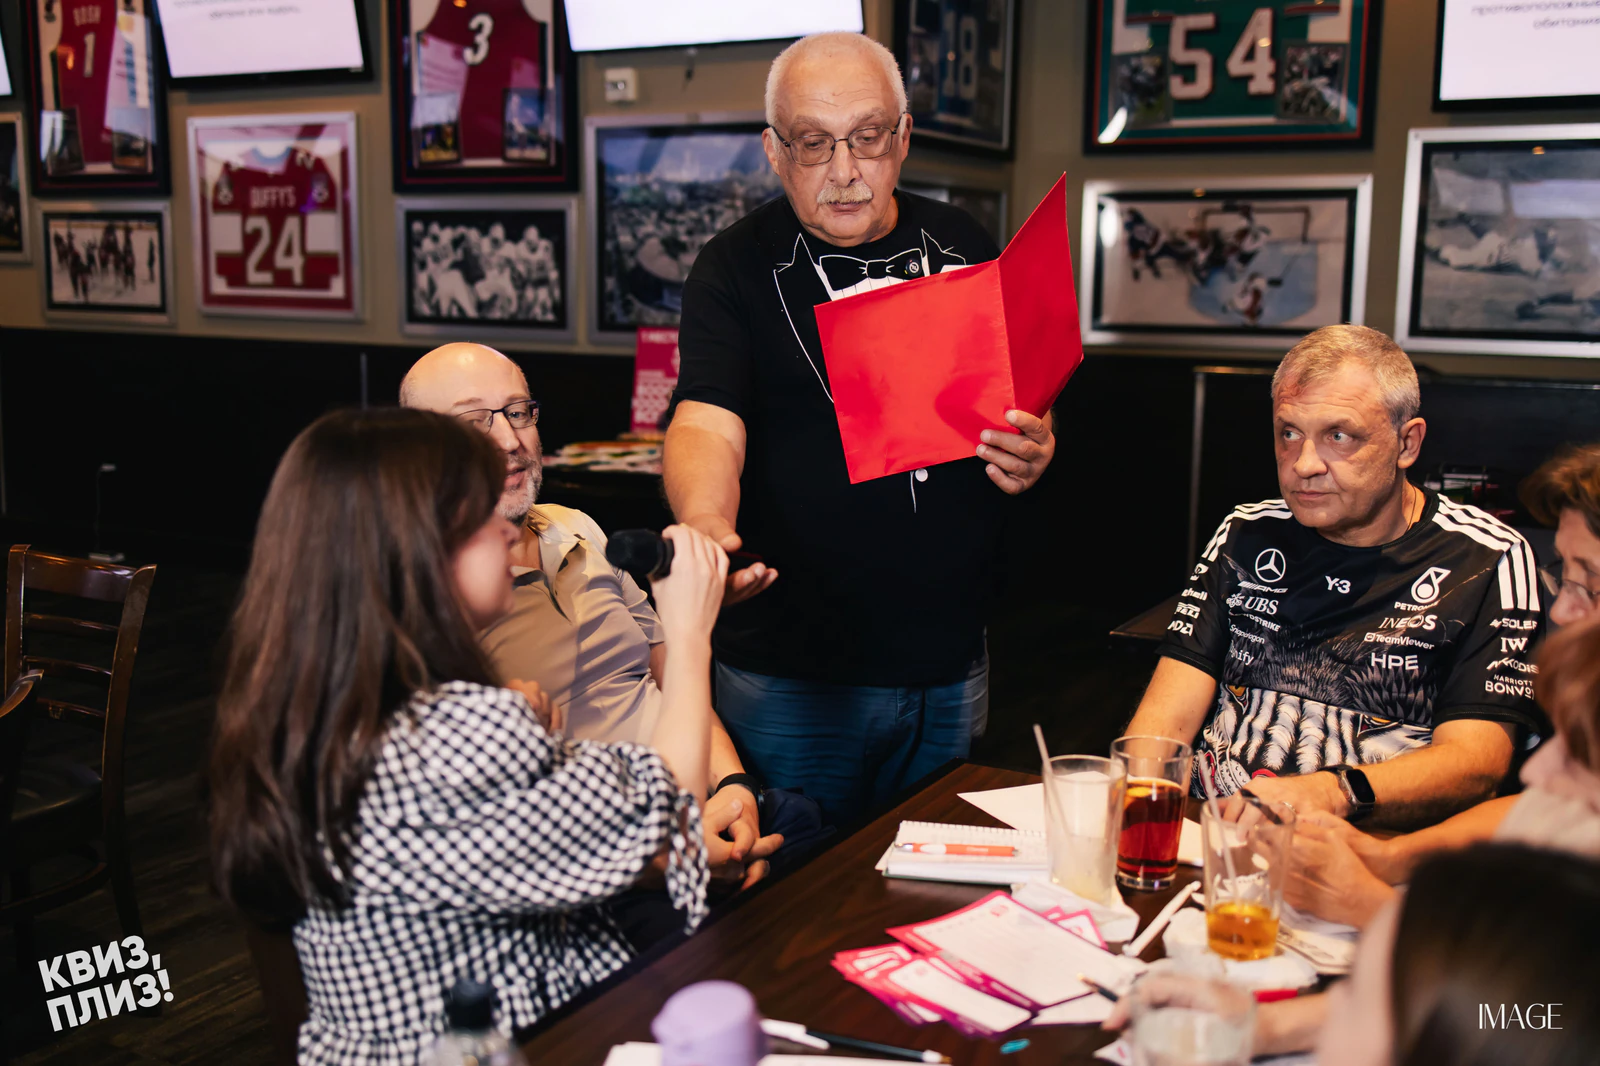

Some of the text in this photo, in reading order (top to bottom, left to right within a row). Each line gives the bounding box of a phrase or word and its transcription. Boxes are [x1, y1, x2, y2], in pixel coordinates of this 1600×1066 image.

[463, 12, 494, 66] 3
[83, 32, 95, 78] 1
[1168, 8, 1277, 99] 54
[245, 215, 304, 286] 24
[1325, 576, 1352, 594] Y-3
[1244, 596, 1279, 615] UBS
[1378, 615, 1438, 631] INEOS
[1376, 634, 1434, 650] TeamViewer
[1371, 652, 1419, 670] HPE
[1493, 674, 1533, 687] MARRIOTT
